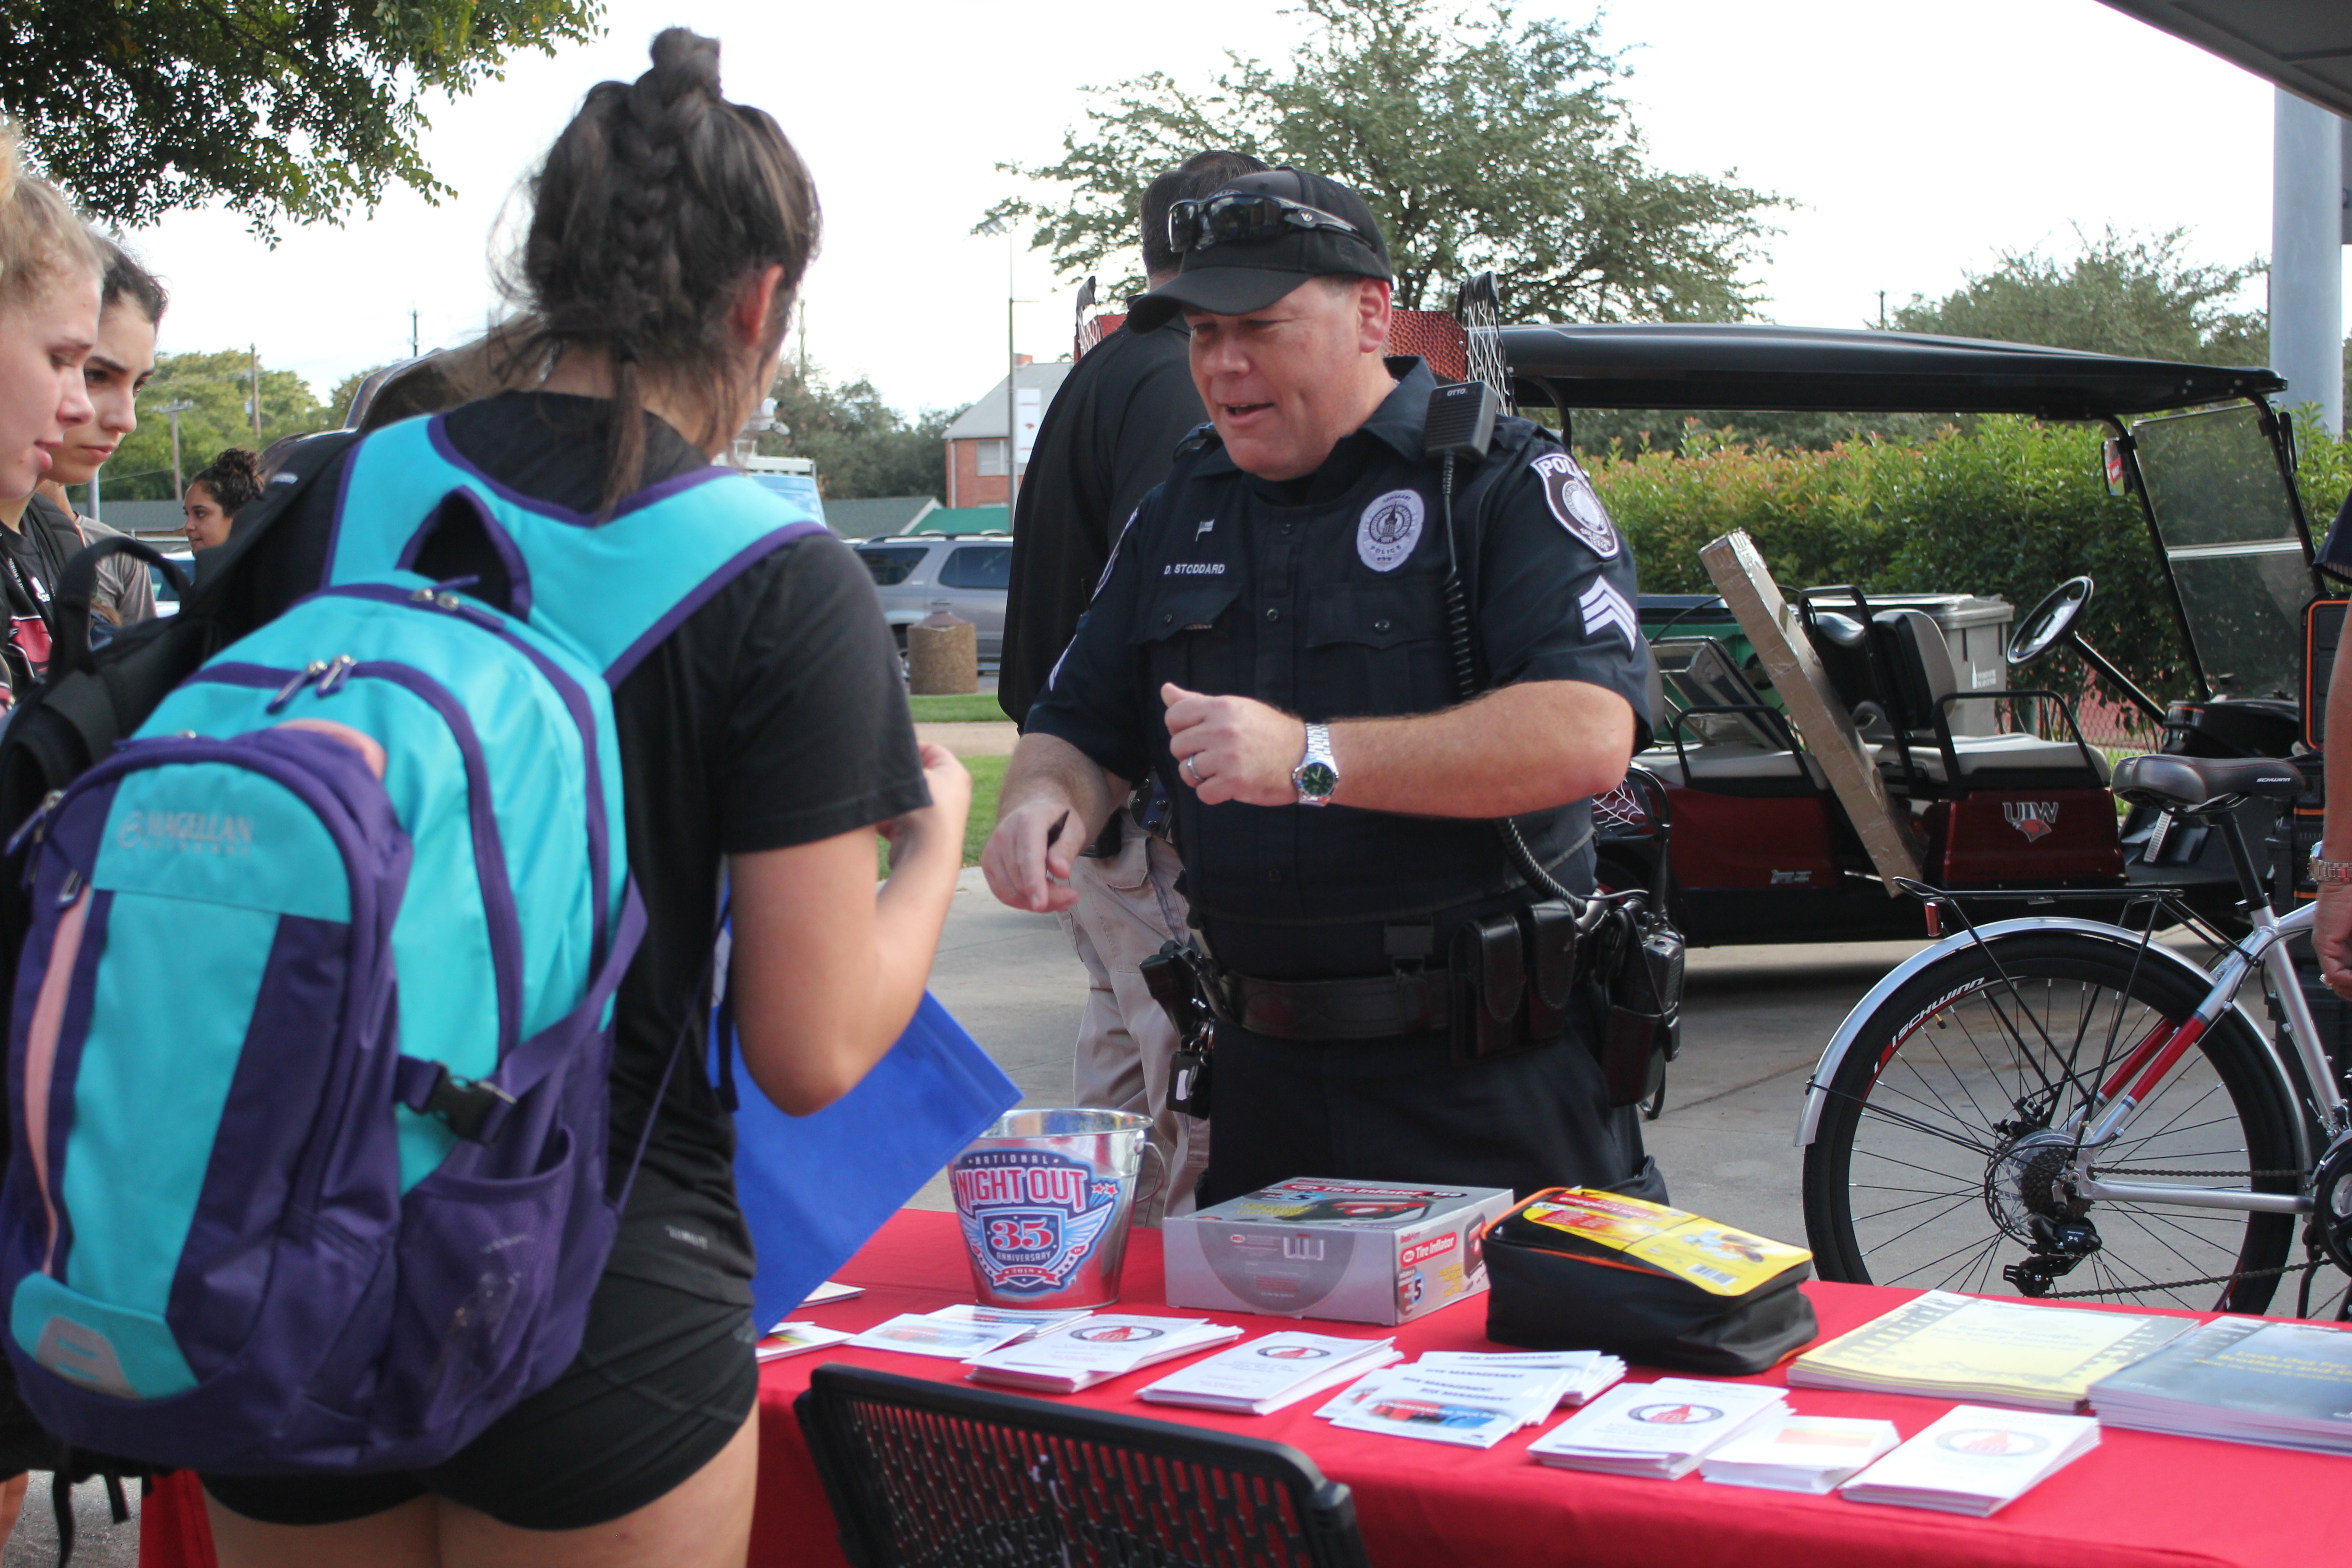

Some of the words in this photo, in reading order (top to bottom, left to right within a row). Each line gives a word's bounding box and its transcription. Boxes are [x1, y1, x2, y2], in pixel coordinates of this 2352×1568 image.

[1447, 388, 1466, 397] OTTO
[1370, 544, 1401, 555] POLICE
[1164, 564, 1171, 575] D.
[1174, 563, 1225, 574] STODDARD
[2002, 801, 2059, 823] UIW
[975, 1154, 1049, 1165] NATIONAL
[956, 1169, 1023, 1210] NIGHT
[1027, 1169, 1085, 1210] OUT
[991, 1217, 1053, 1250] 35
[996, 1250, 1051, 1262] ANNIVERSARY
[1416, 1245, 1429, 1259] Tire
[1429, 1236, 1455, 1254] Inflator
[1413, 1278, 1421, 1301] 5
